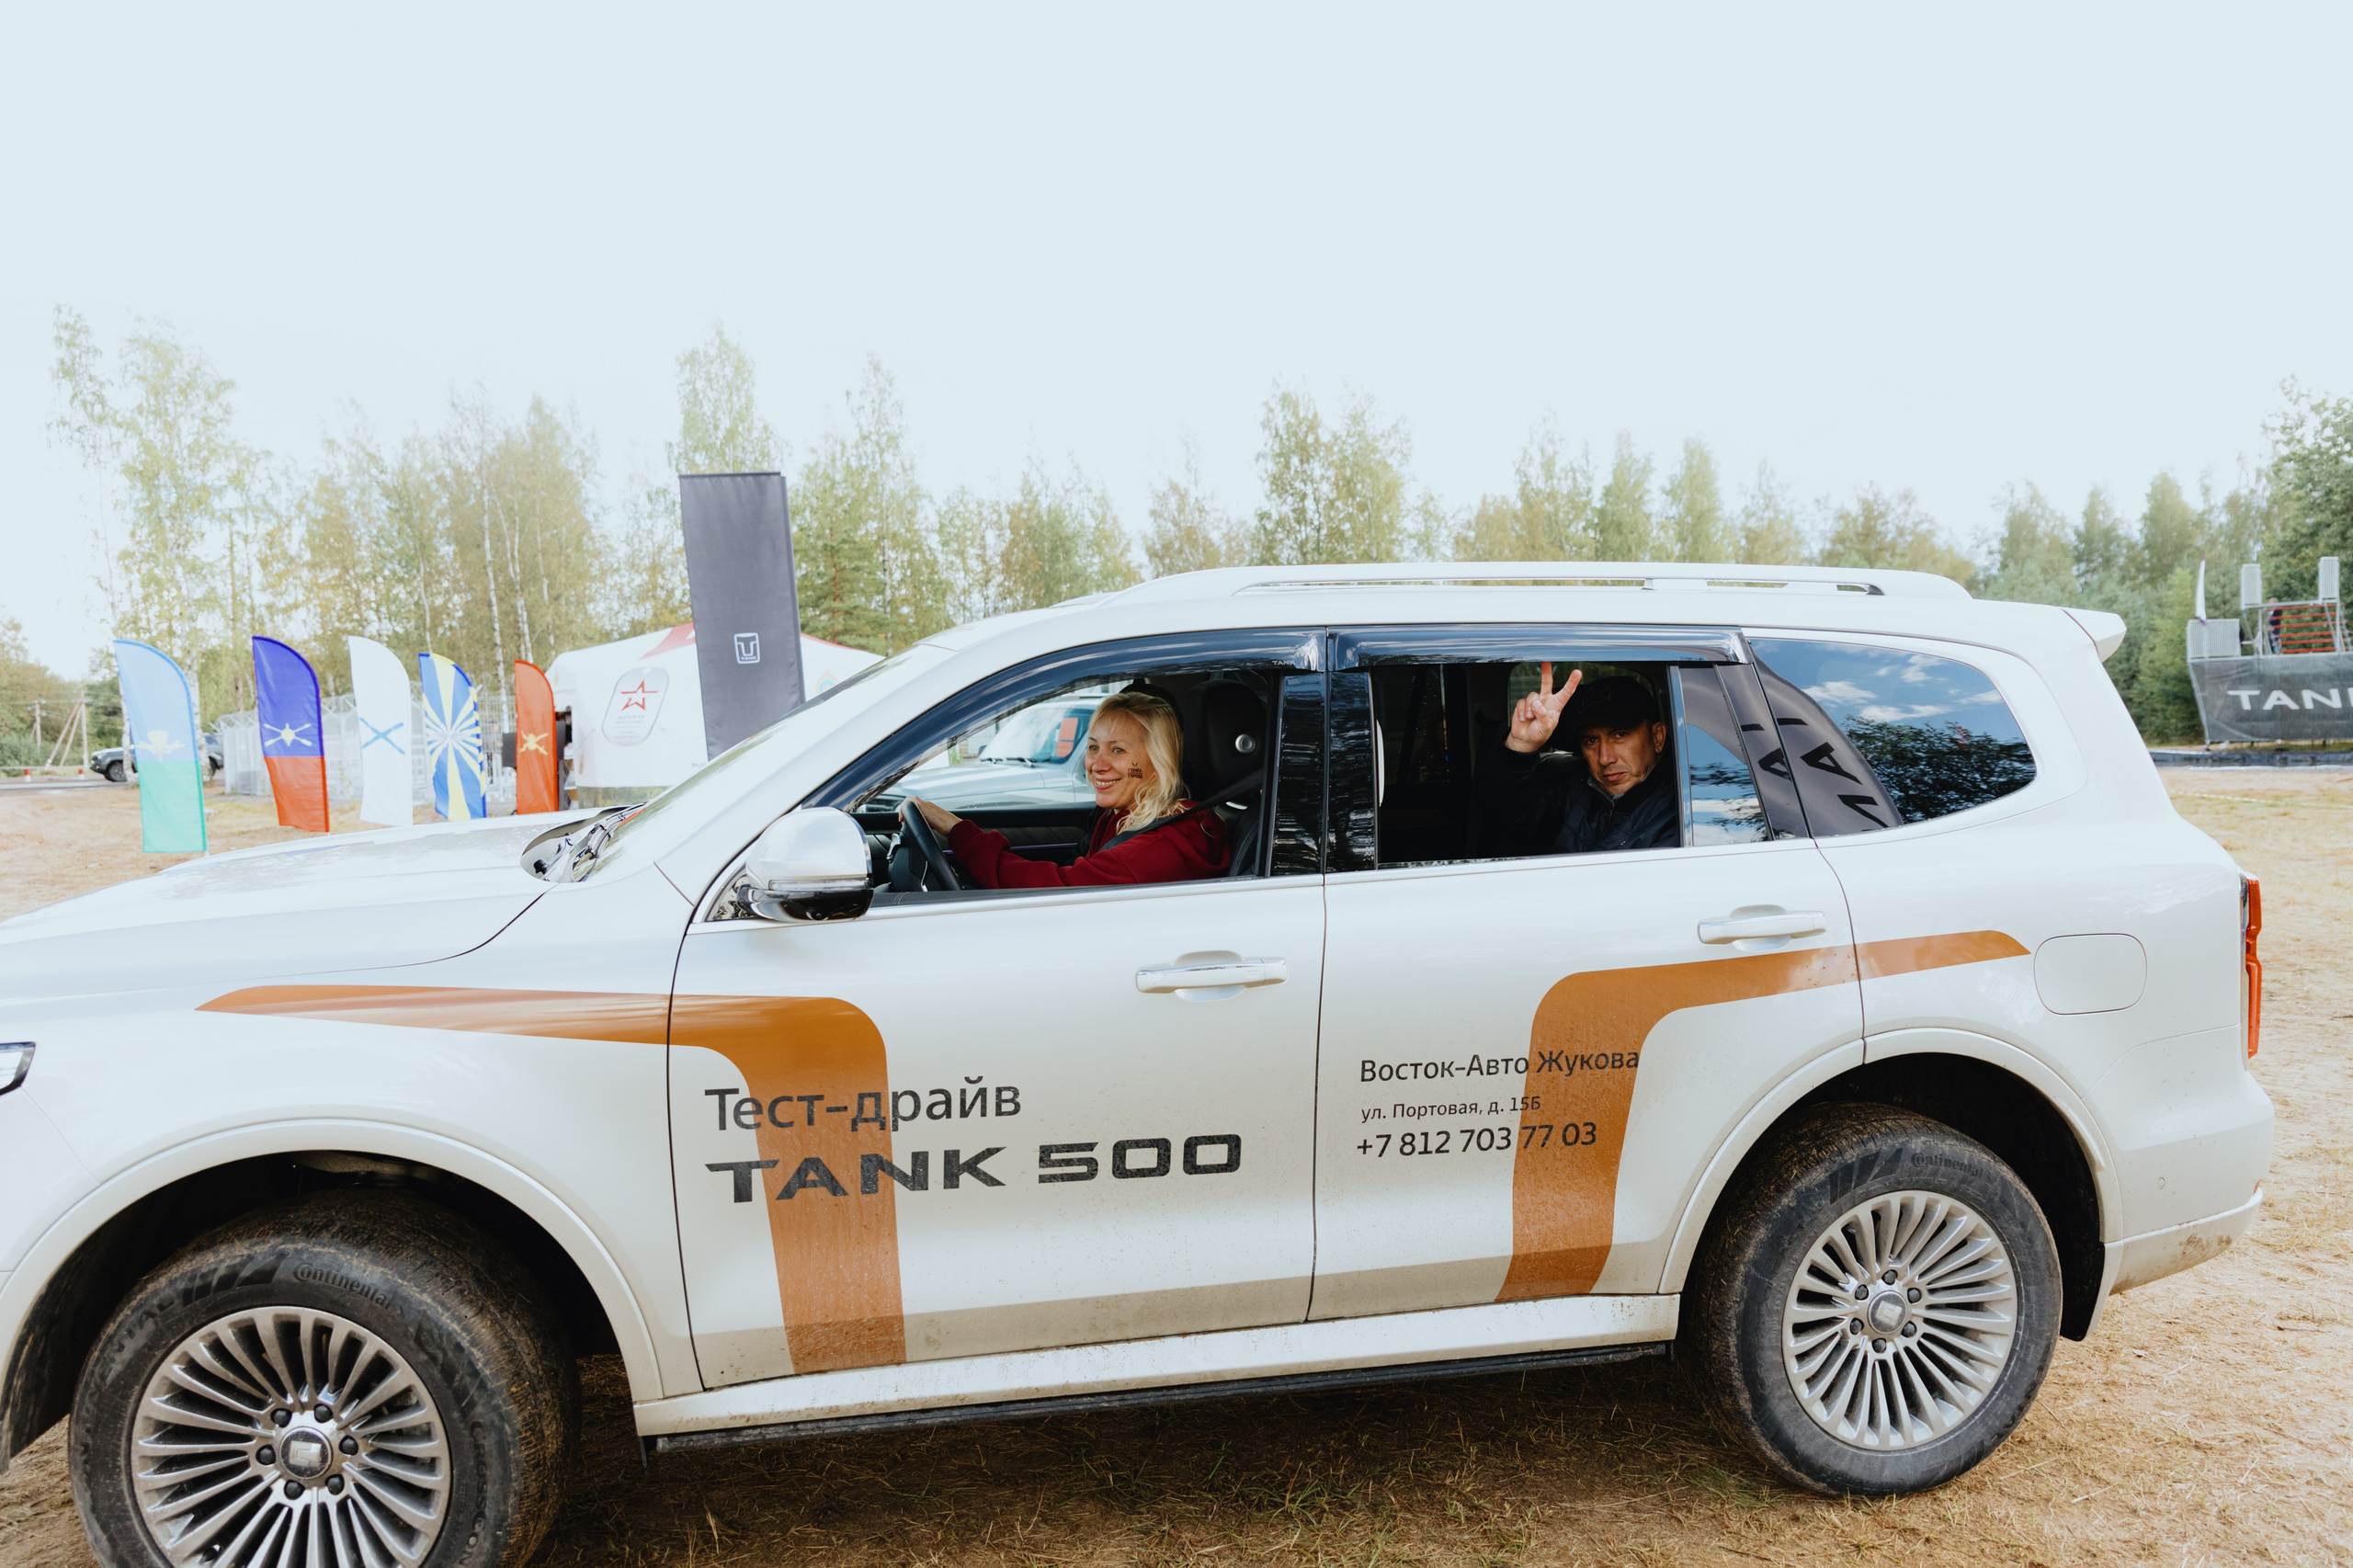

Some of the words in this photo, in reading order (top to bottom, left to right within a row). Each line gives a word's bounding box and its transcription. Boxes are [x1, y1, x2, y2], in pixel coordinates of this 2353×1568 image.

[2226, 687, 2353, 710] TAN
[1360, 1054, 1529, 1082] Восток-Авто
[1536, 1051, 1640, 1077] Жукова
[704, 1075, 1022, 1132] Тест-драйв
[1361, 1107, 1387, 1123] ул.
[1392, 1102, 1483, 1119] Портовая,
[1487, 1101, 1505, 1115] д.
[1357, 1134, 1392, 1158] +7
[1399, 1131, 1450, 1156] 812
[1460, 1128, 1512, 1153] 703
[1521, 1125, 1553, 1149] 77
[1562, 1122, 1597, 1146] 03
[704, 1146, 1007, 1203] TANK
[1039, 1134, 1242, 1184] 500
[1912, 1153, 1984, 1178] Continental
[293, 1262, 392, 1310] Continental
